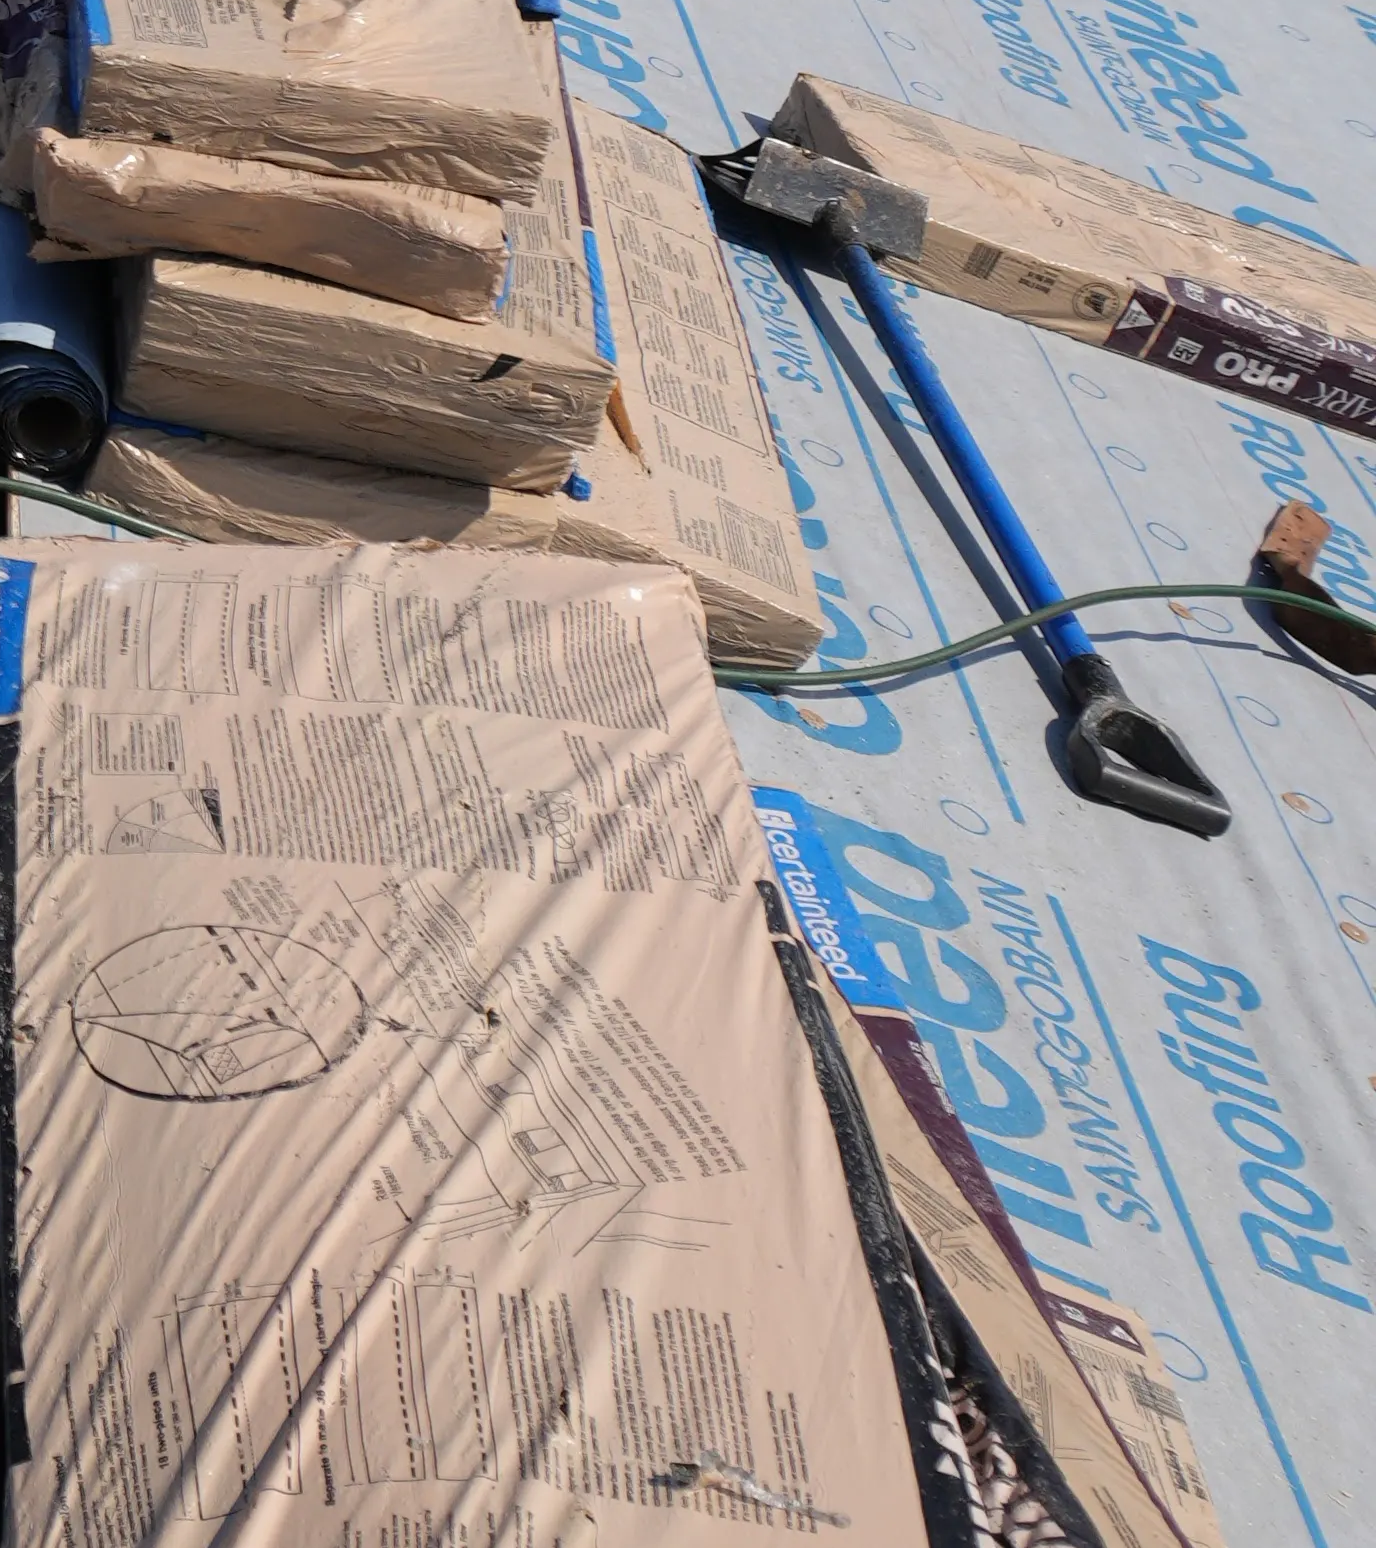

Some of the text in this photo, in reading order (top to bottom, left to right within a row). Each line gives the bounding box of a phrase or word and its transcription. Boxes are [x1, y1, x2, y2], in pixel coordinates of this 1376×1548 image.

[1214, 350, 1301, 395] PRO
[762, 828, 869, 982] certainteed
[1138, 936, 1368, 1311] Roofing
